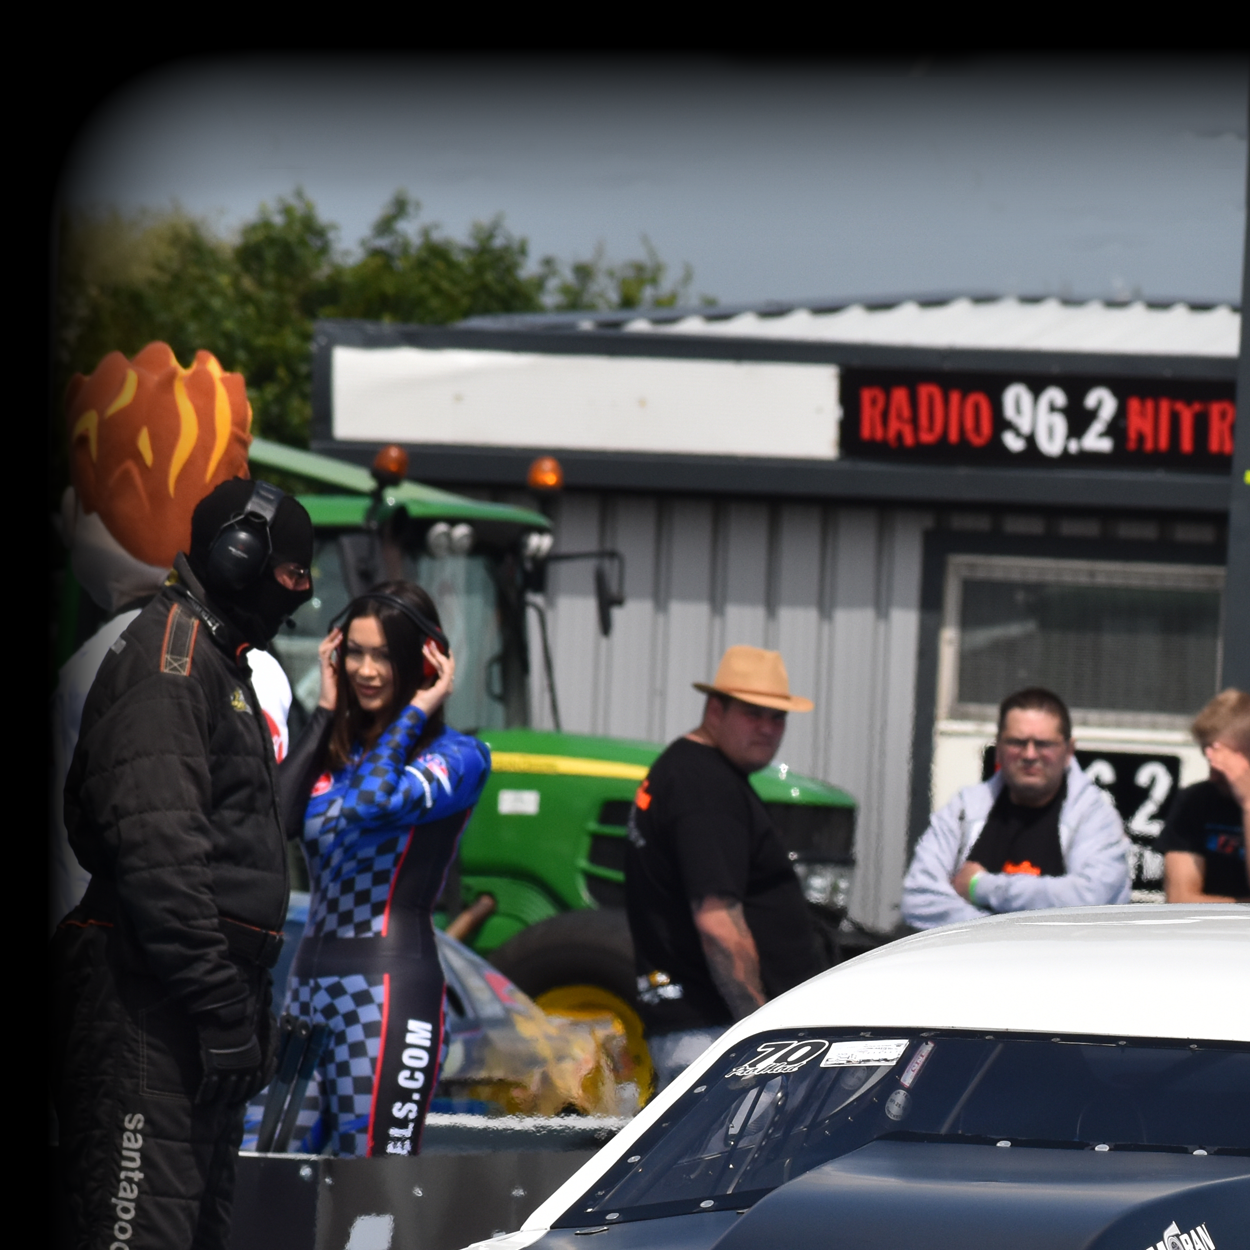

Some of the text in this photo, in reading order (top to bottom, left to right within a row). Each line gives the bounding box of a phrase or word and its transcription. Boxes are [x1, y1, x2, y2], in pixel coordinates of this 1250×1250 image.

[858, 383, 994, 448] RADIO
[1001, 383, 1118, 457] 96.2
[743, 1040, 830, 1069] 70
